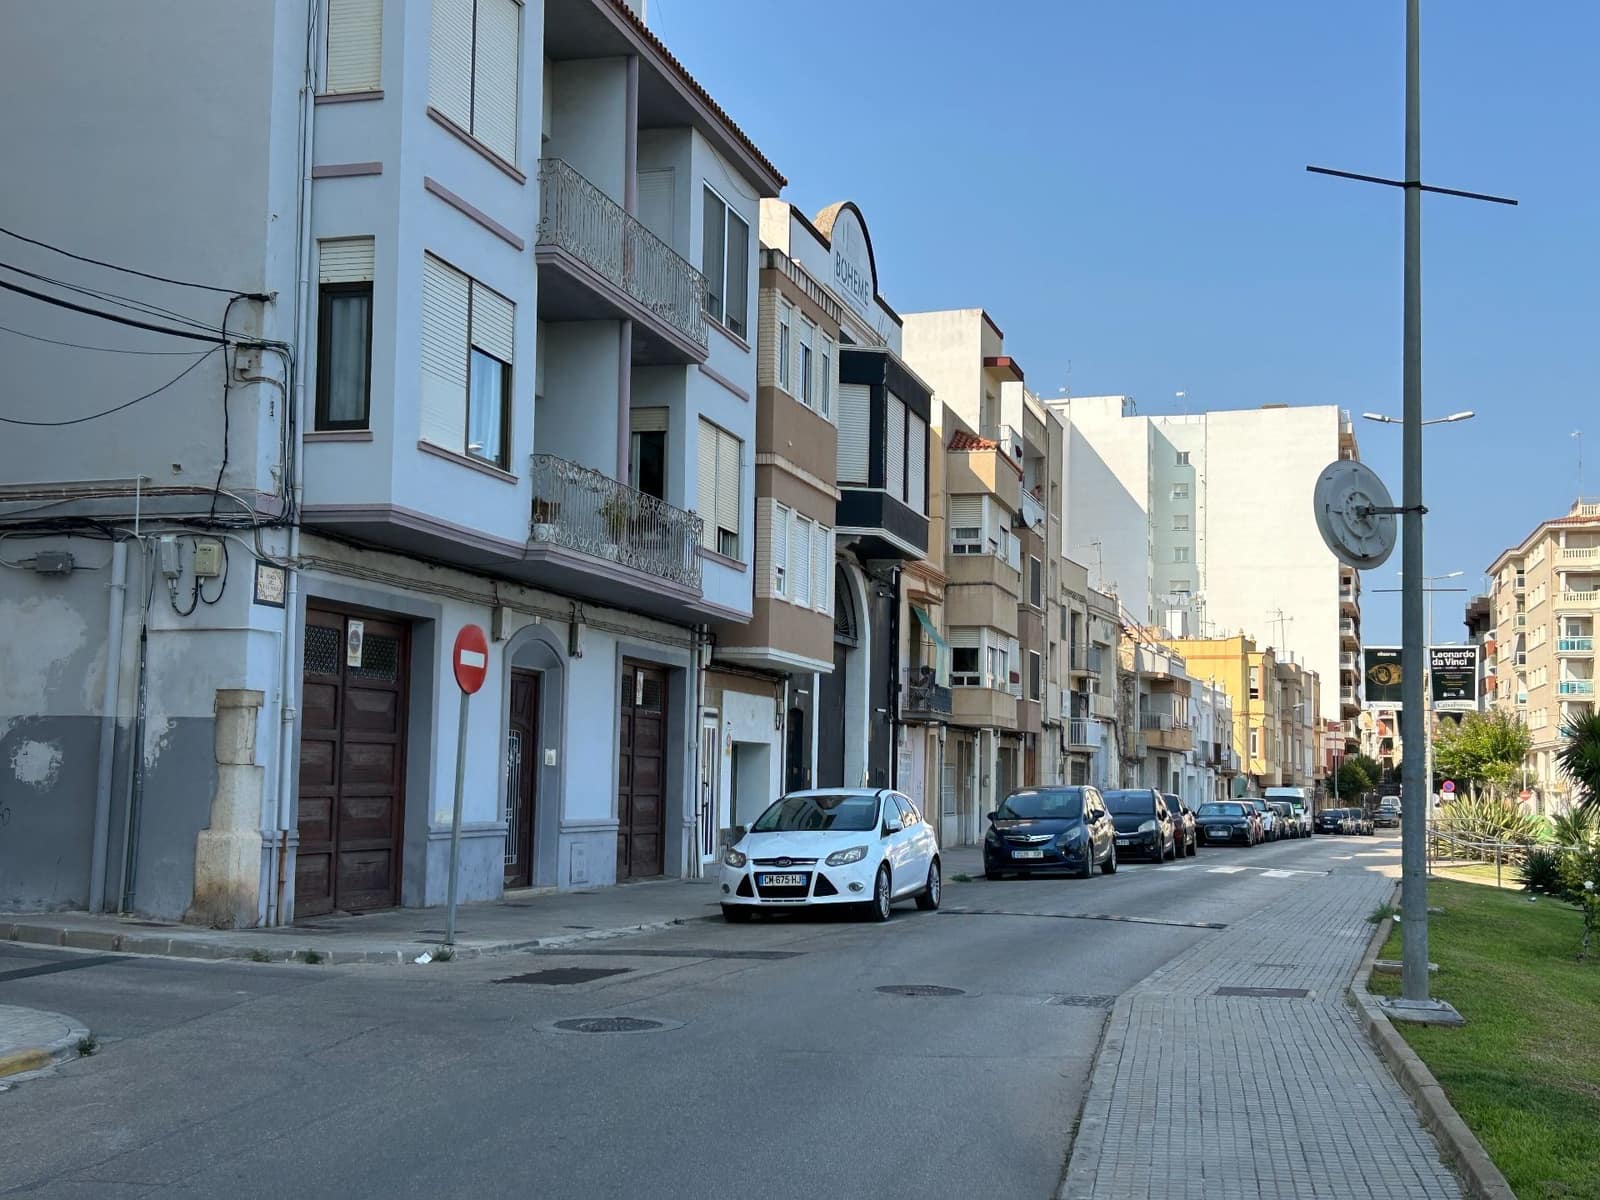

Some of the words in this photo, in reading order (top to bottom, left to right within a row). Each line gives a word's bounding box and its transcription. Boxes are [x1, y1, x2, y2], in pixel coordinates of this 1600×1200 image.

[835, 250, 869, 306] BOHEME
[1431, 650, 1475, 658] Leonardo
[1432, 658, 1444, 666] da
[1445, 658, 1467, 666] Vinci
